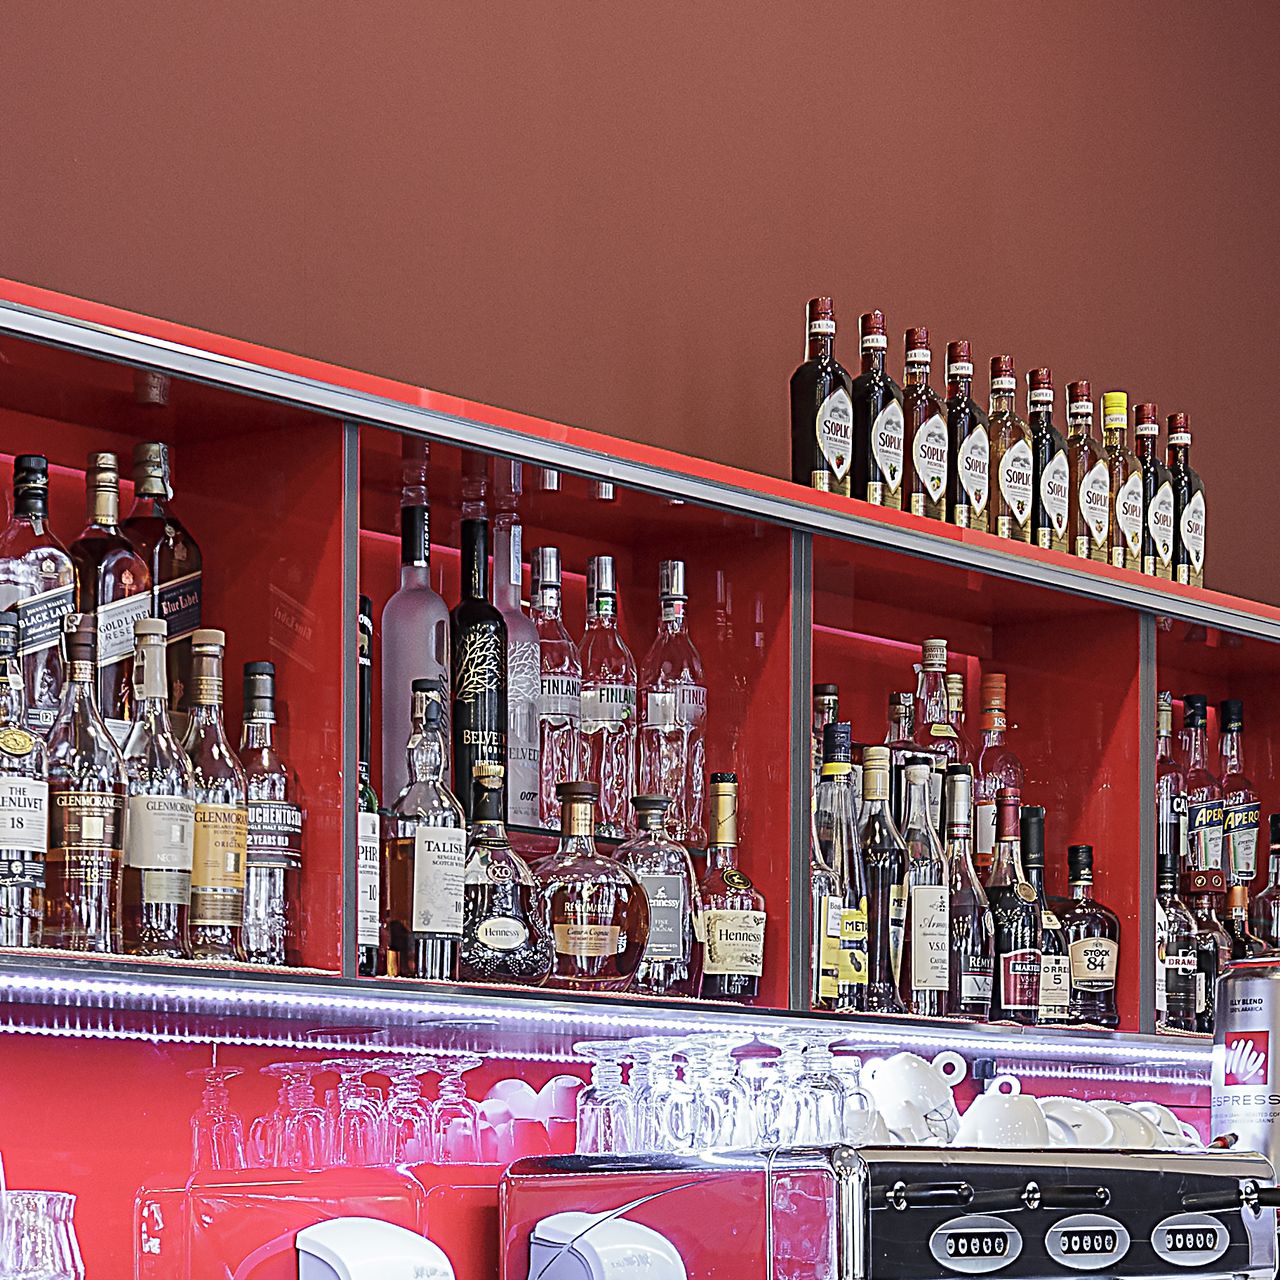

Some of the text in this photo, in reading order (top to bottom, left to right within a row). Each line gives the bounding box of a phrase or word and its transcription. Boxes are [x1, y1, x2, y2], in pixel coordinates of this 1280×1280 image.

[18, 613, 49, 629] BLACK
[100, 620, 124, 633] GOLD
[8, 787, 26, 796] THE
[10, 817, 24, 829] 18
[253, 836, 276, 846] YEARS
[277, 836, 289, 846] OLD
[86, 867, 99, 880] 18
[368, 885, 376, 901] 10
[455, 901, 462, 913] 10
[483, 927, 520, 938] Hennessy
[1086, 957, 1106, 971] 84
[1053, 975, 1061, 985] 5
[1226, 1039, 1265, 1081] illy
